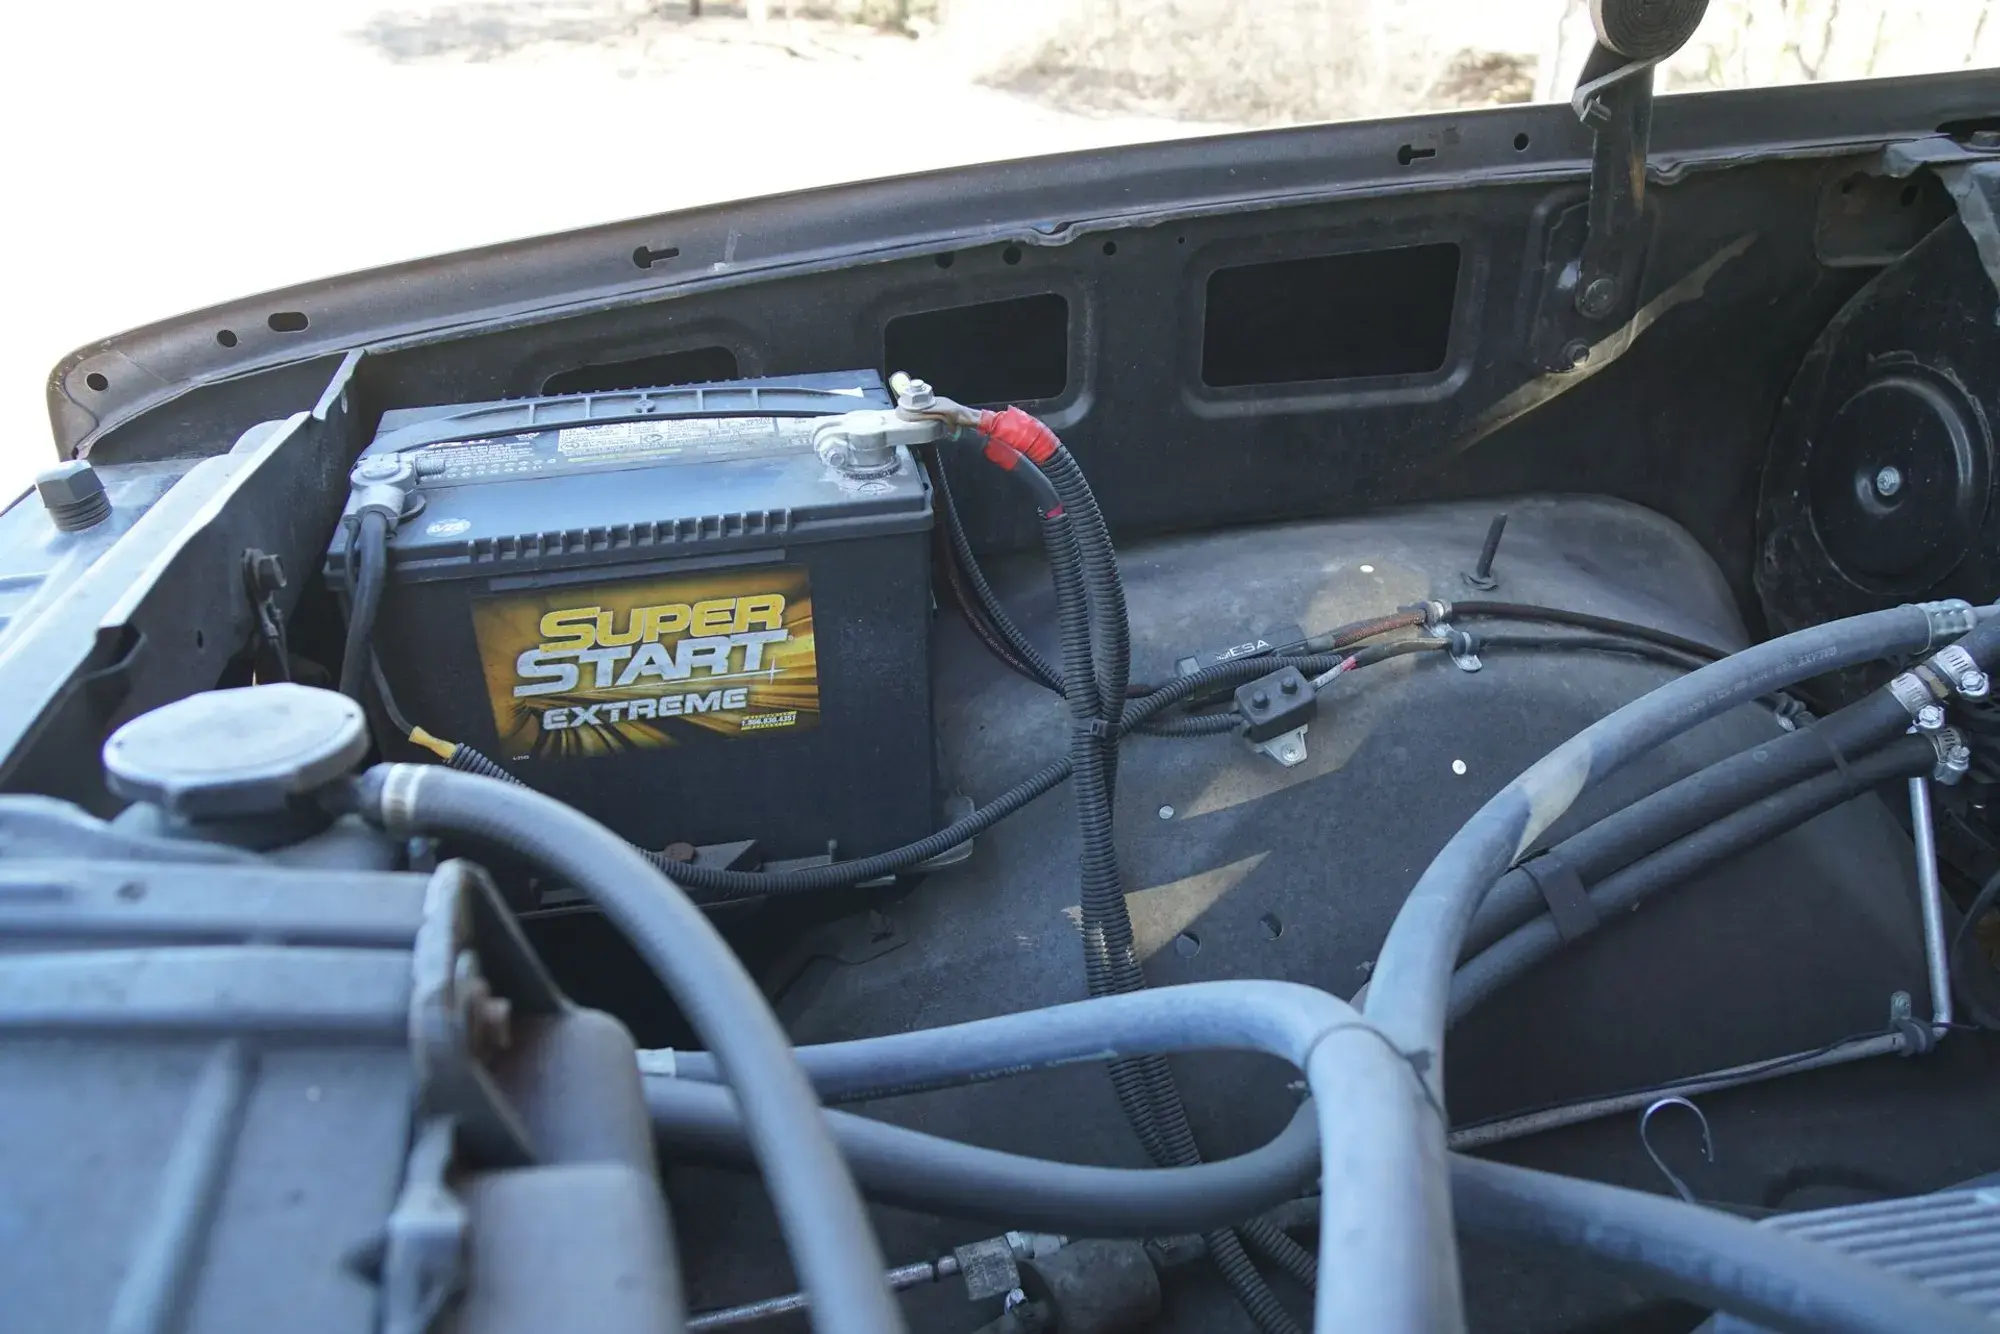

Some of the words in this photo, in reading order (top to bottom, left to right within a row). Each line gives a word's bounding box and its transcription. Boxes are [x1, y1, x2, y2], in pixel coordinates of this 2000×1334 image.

[538, 594, 786, 653] SUPER
[513, 628, 789, 697] START
[543, 687, 749, 730] EXTREME
